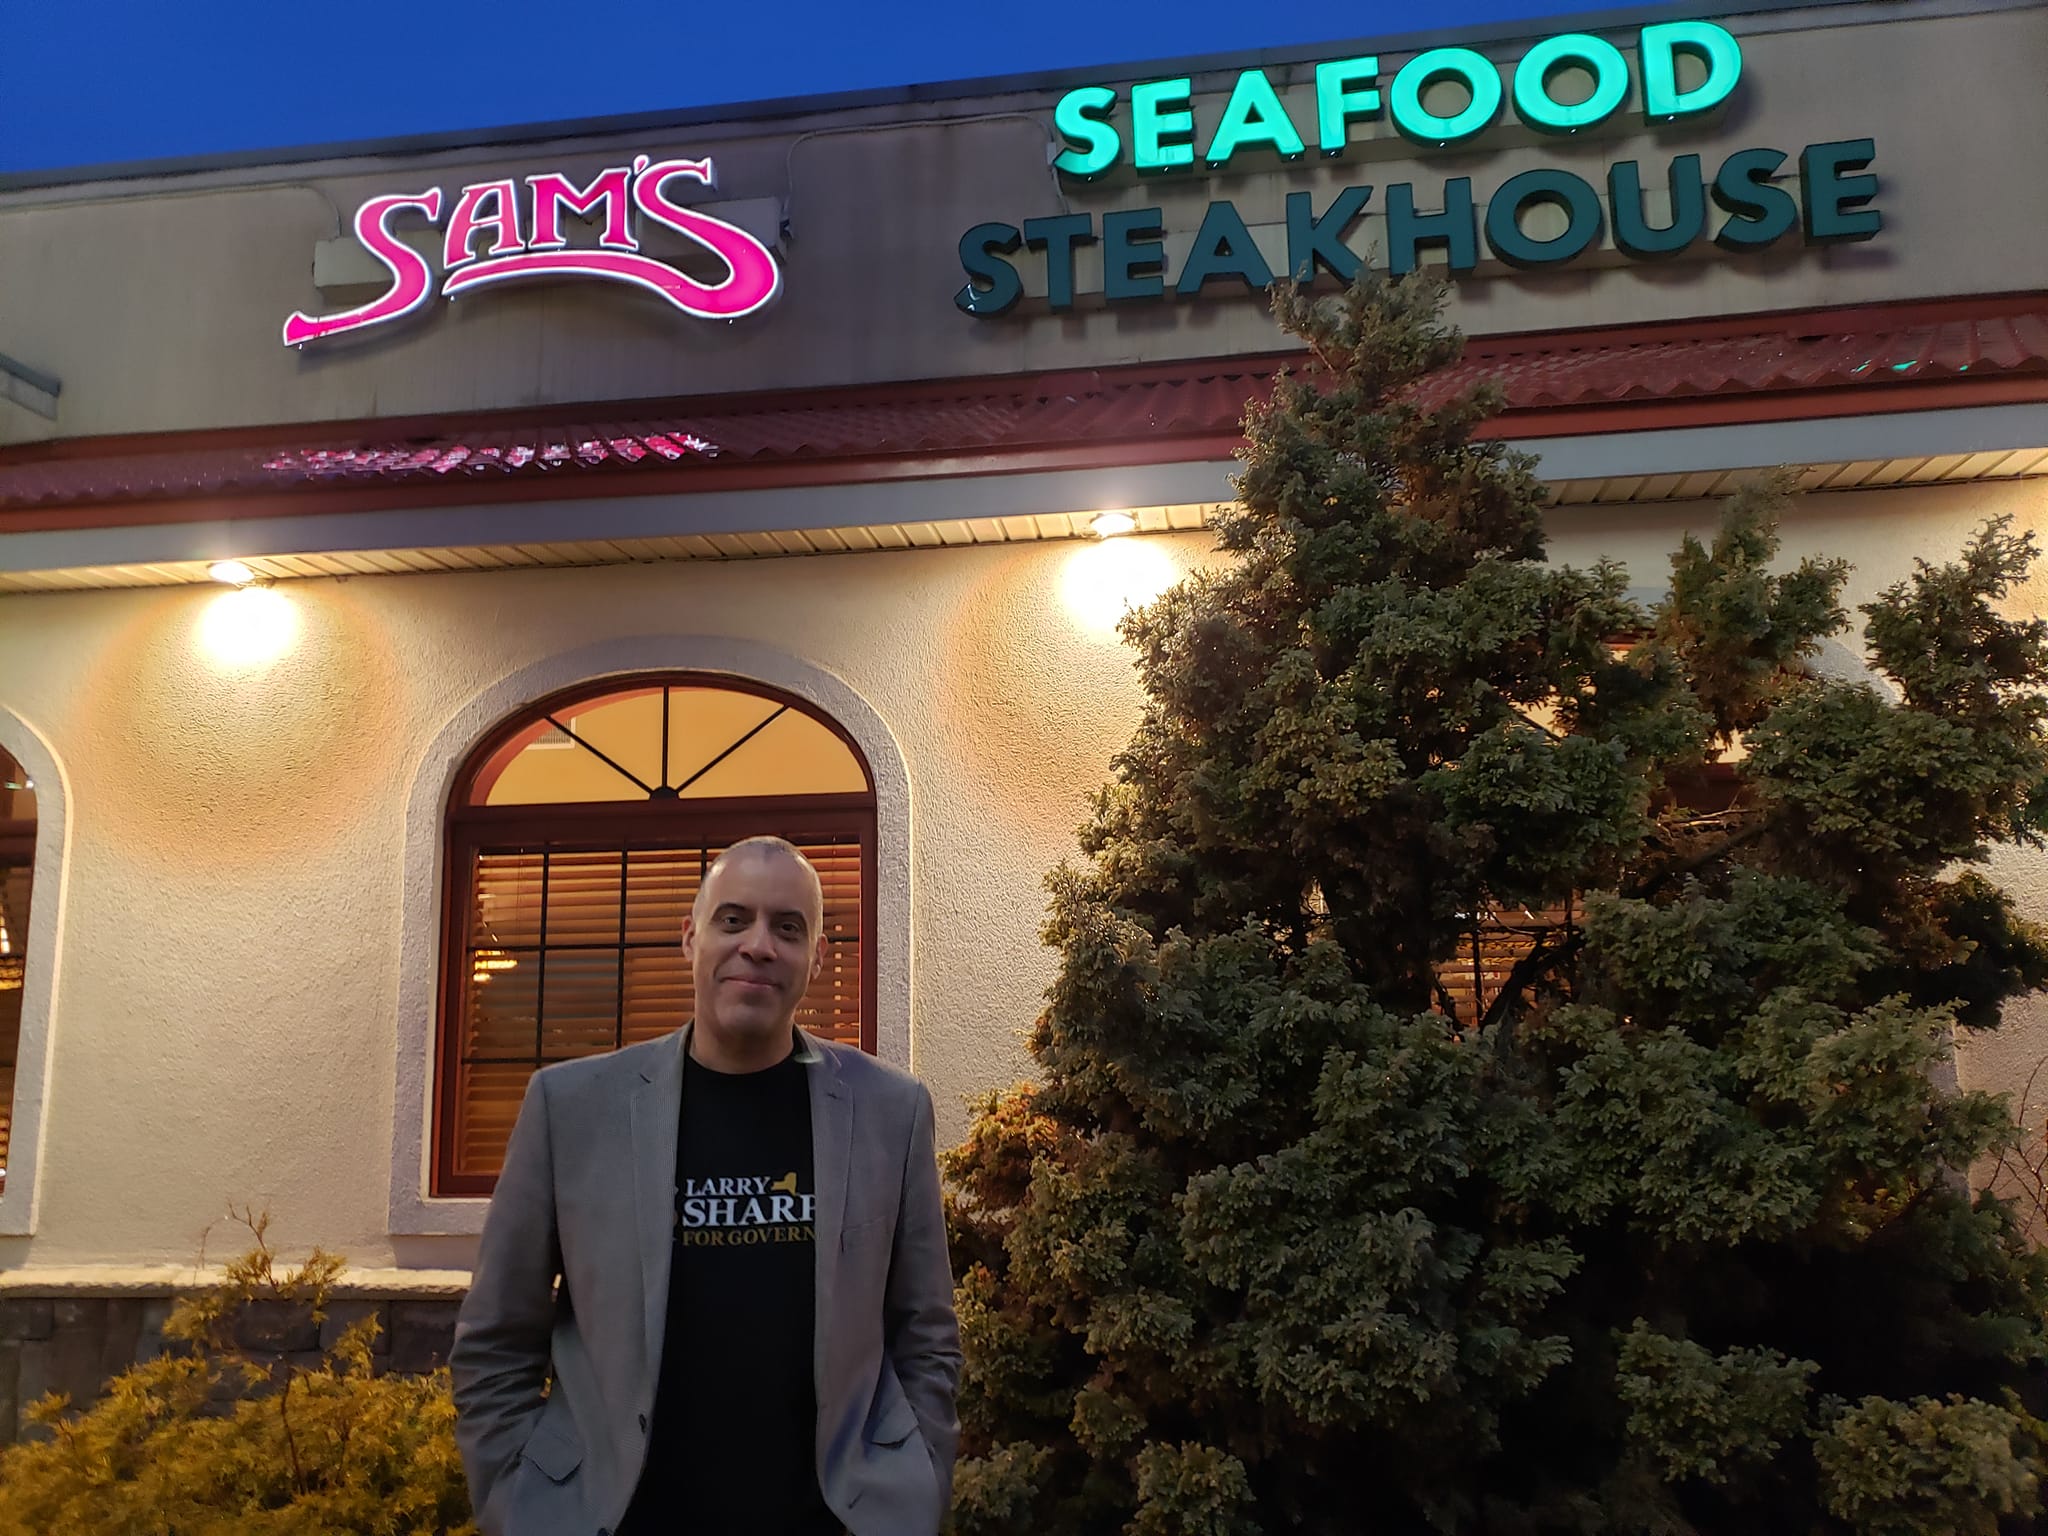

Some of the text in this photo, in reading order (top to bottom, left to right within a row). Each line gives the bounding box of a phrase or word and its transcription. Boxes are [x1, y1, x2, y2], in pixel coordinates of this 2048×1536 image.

[1055, 21, 1743, 183] SEAFOOD
[283, 155, 780, 345] SAM'S
[956, 139, 1880, 317] STEAKHOUSE
[682, 1230, 725, 1246] FOR
[686, 1176, 770, 1197] LARRY
